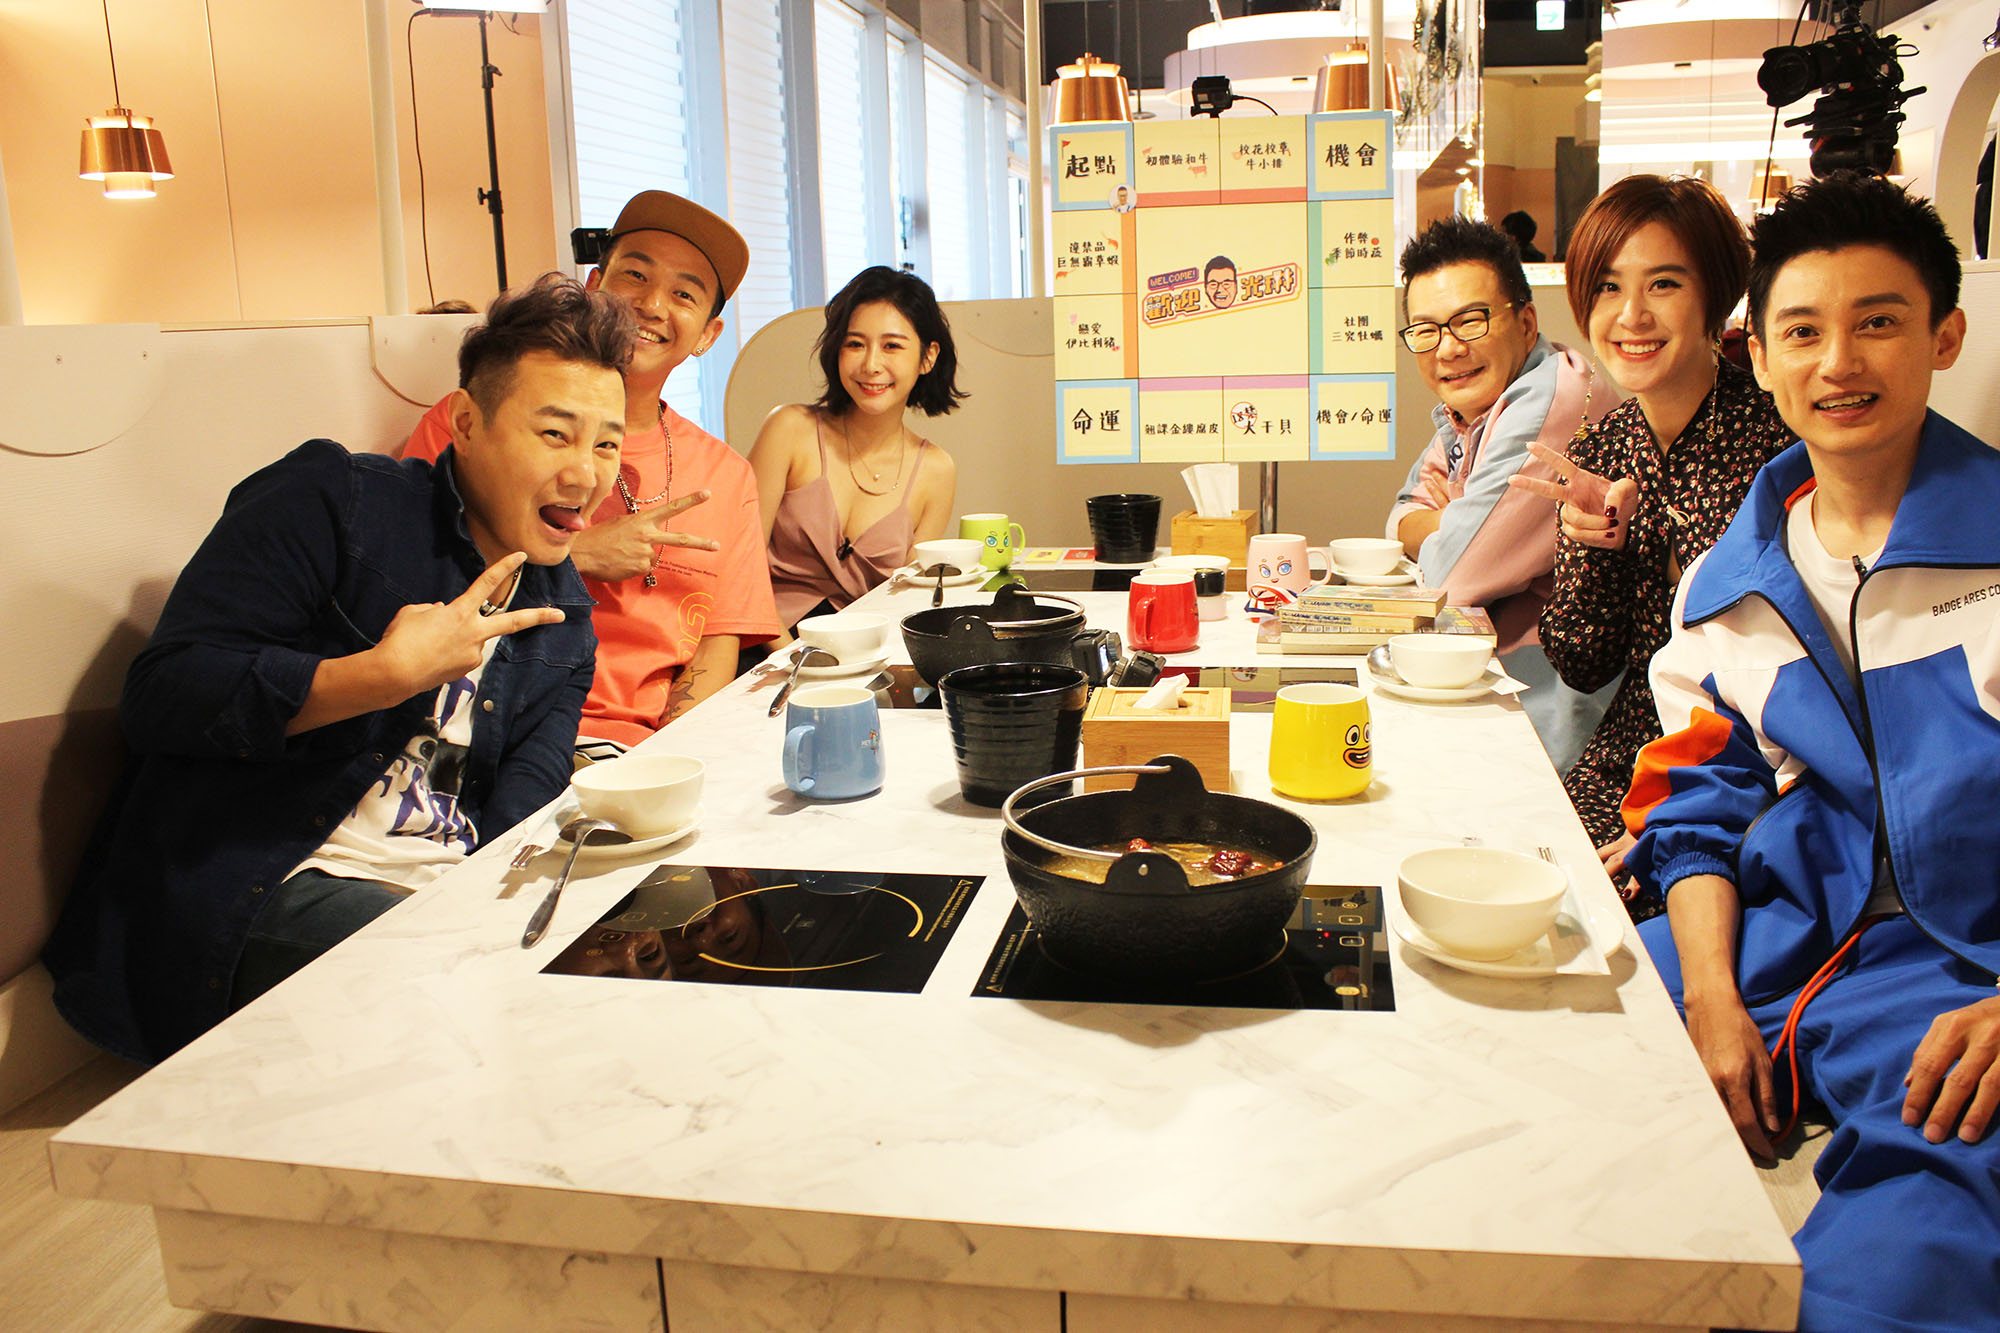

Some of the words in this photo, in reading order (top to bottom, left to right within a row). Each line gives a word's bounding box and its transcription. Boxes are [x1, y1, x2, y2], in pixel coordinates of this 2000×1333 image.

[1146, 152, 1208, 166] 初體驗和牛
[1246, 158, 1282, 170] 牛小排
[1325, 142, 1378, 168] 機會
[1065, 154, 1116, 179] 起點
[1150, 270, 1196, 286] WELCOME!
[1146, 288, 1201, 320] 歡迎
[1344, 315, 1369, 327] 社團
[1072, 408, 1121, 435] 命運
[1316, 407, 1393, 425] 機會/命運
[1932, 597, 1962, 617] BADGE
[1964, 588, 1987, 606] ARES
